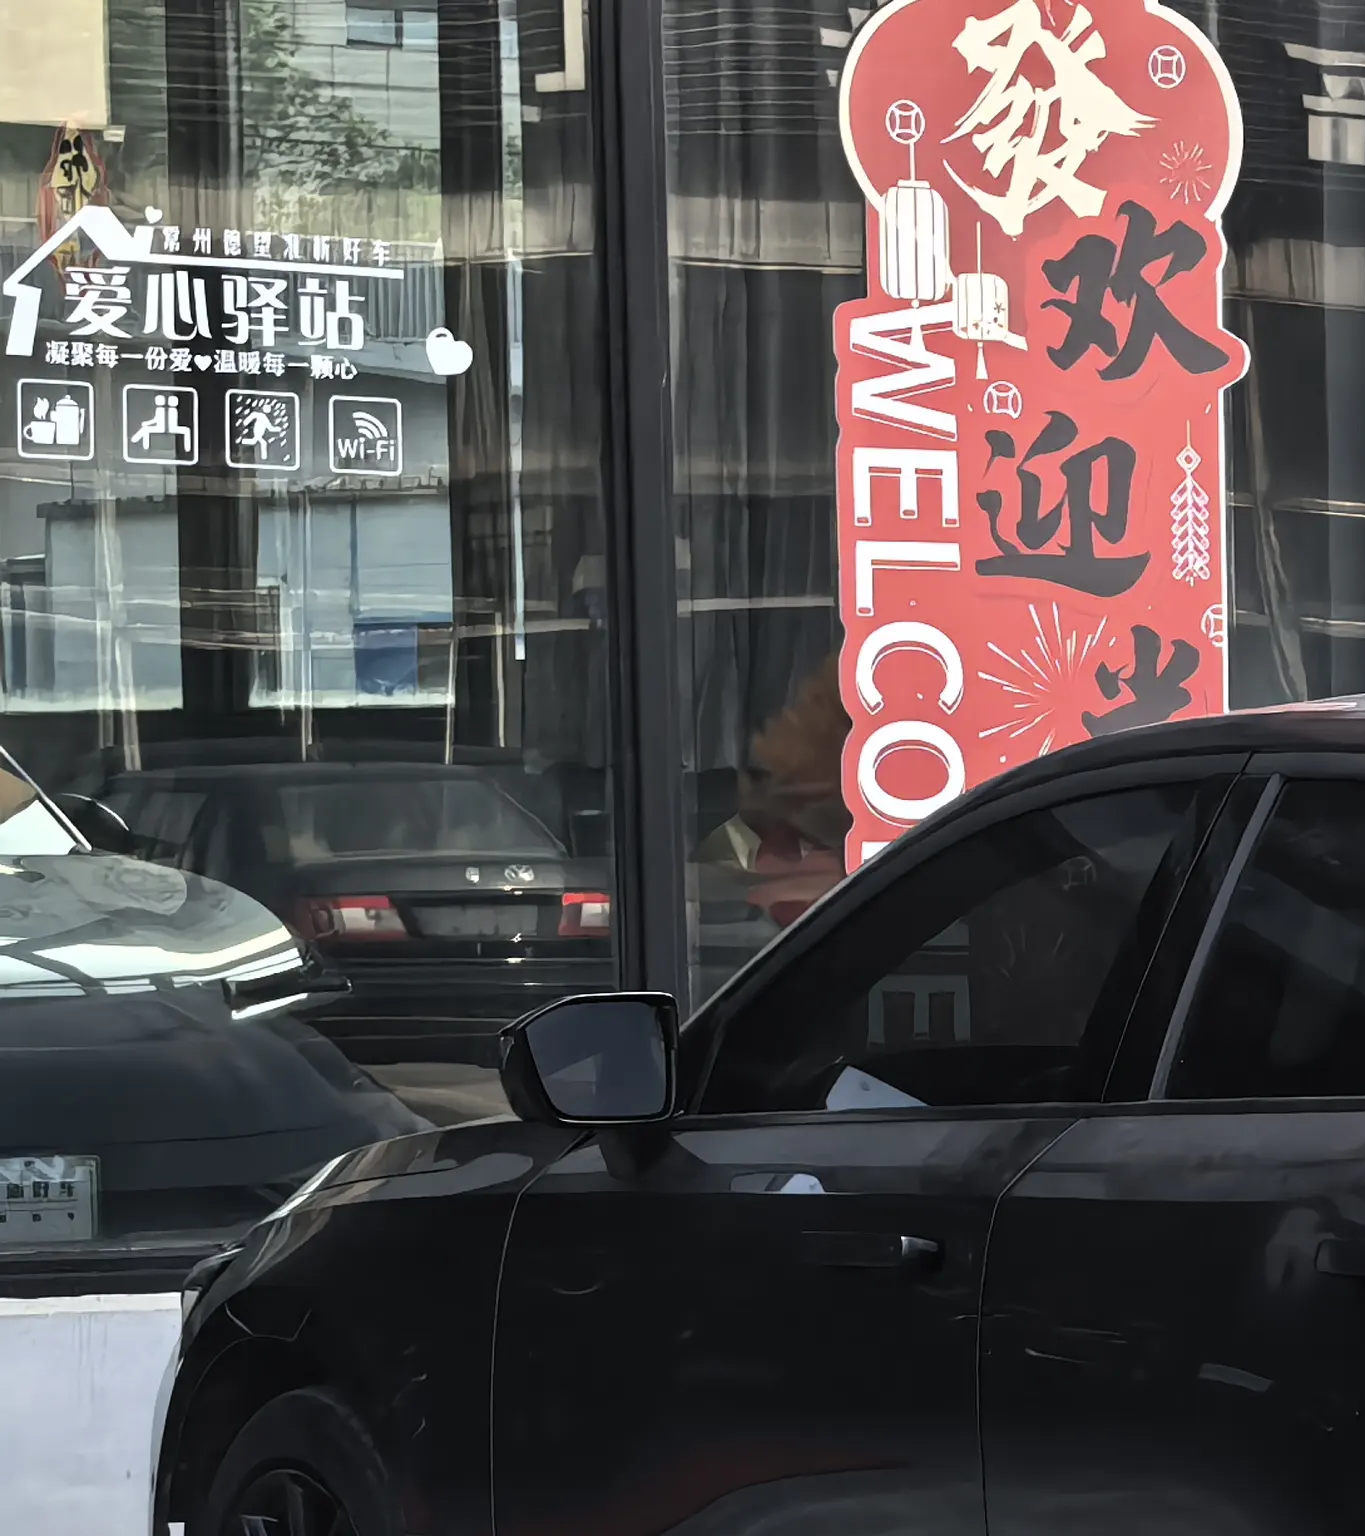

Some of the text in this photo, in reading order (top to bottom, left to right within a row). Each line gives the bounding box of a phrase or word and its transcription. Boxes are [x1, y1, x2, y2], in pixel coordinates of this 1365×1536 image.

[64, 266, 365, 351] 爱心驿站
[337, 437, 396, 463] Wi-Fi
